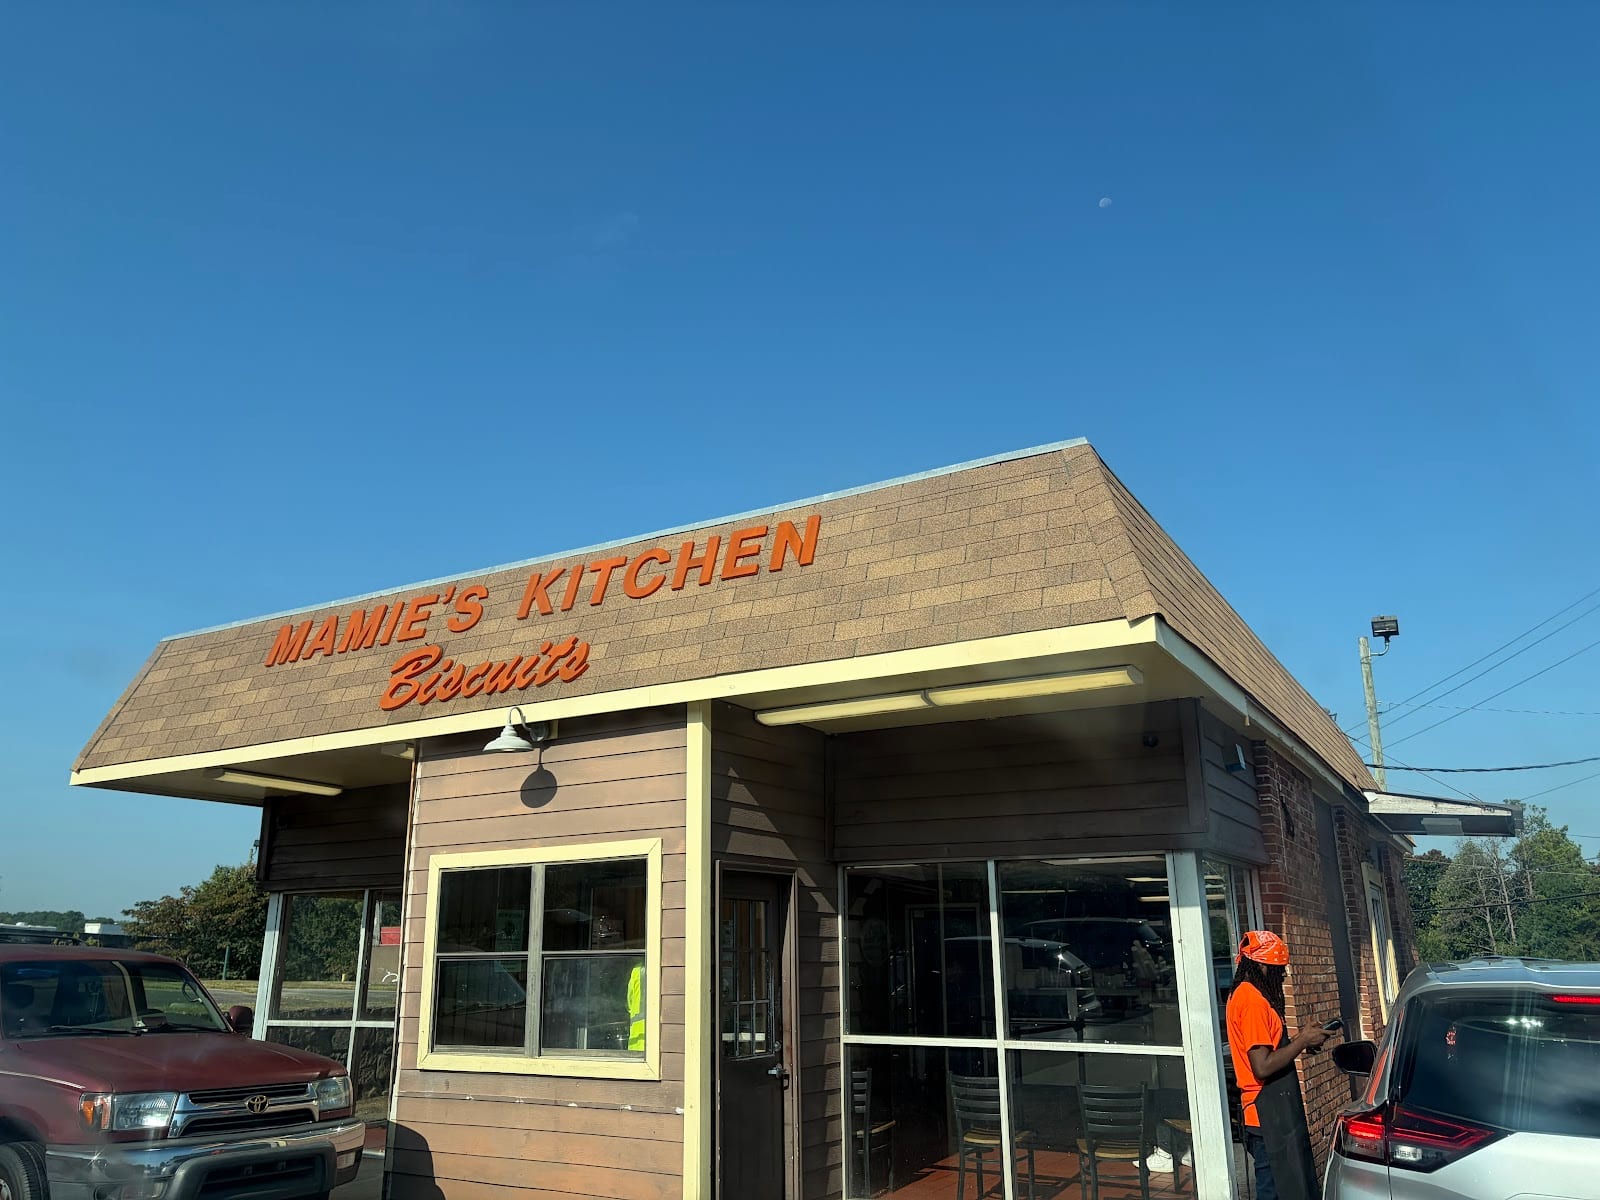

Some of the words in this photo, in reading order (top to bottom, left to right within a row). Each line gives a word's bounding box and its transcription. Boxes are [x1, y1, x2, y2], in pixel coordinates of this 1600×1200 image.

[265, 585, 488, 667] MAMIE'S
[517, 515, 821, 619] KITCHEN
[379, 636, 590, 711] Biscuits
